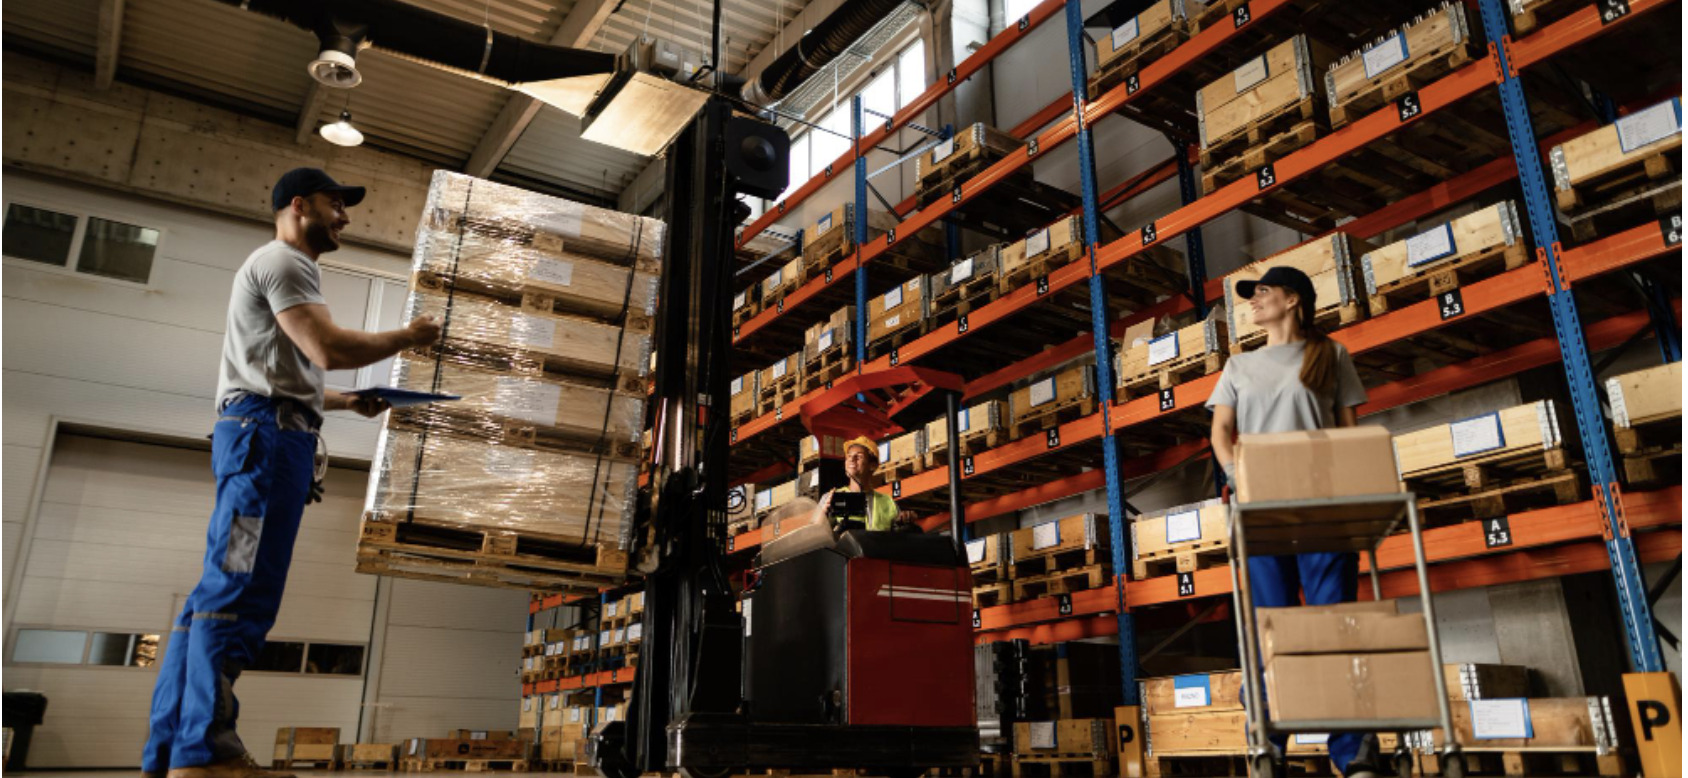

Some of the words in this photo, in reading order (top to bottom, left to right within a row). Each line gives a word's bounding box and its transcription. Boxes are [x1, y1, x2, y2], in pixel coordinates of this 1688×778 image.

[1605, 4, 1625, 21] 6.1
[1404, 97, 1412, 106] C
[1402, 105, 1419, 118] 5.3
[1262, 167, 1269, 176] C
[1445, 293, 1454, 305] B
[1443, 303, 1461, 318] 5.3
[1492, 519, 1501, 531] A
[1488, 532, 1508, 545] 5.3
[1182, 574, 1189, 584] A
[1636, 701, 1671, 741] P
[1119, 724, 1134, 753] P
